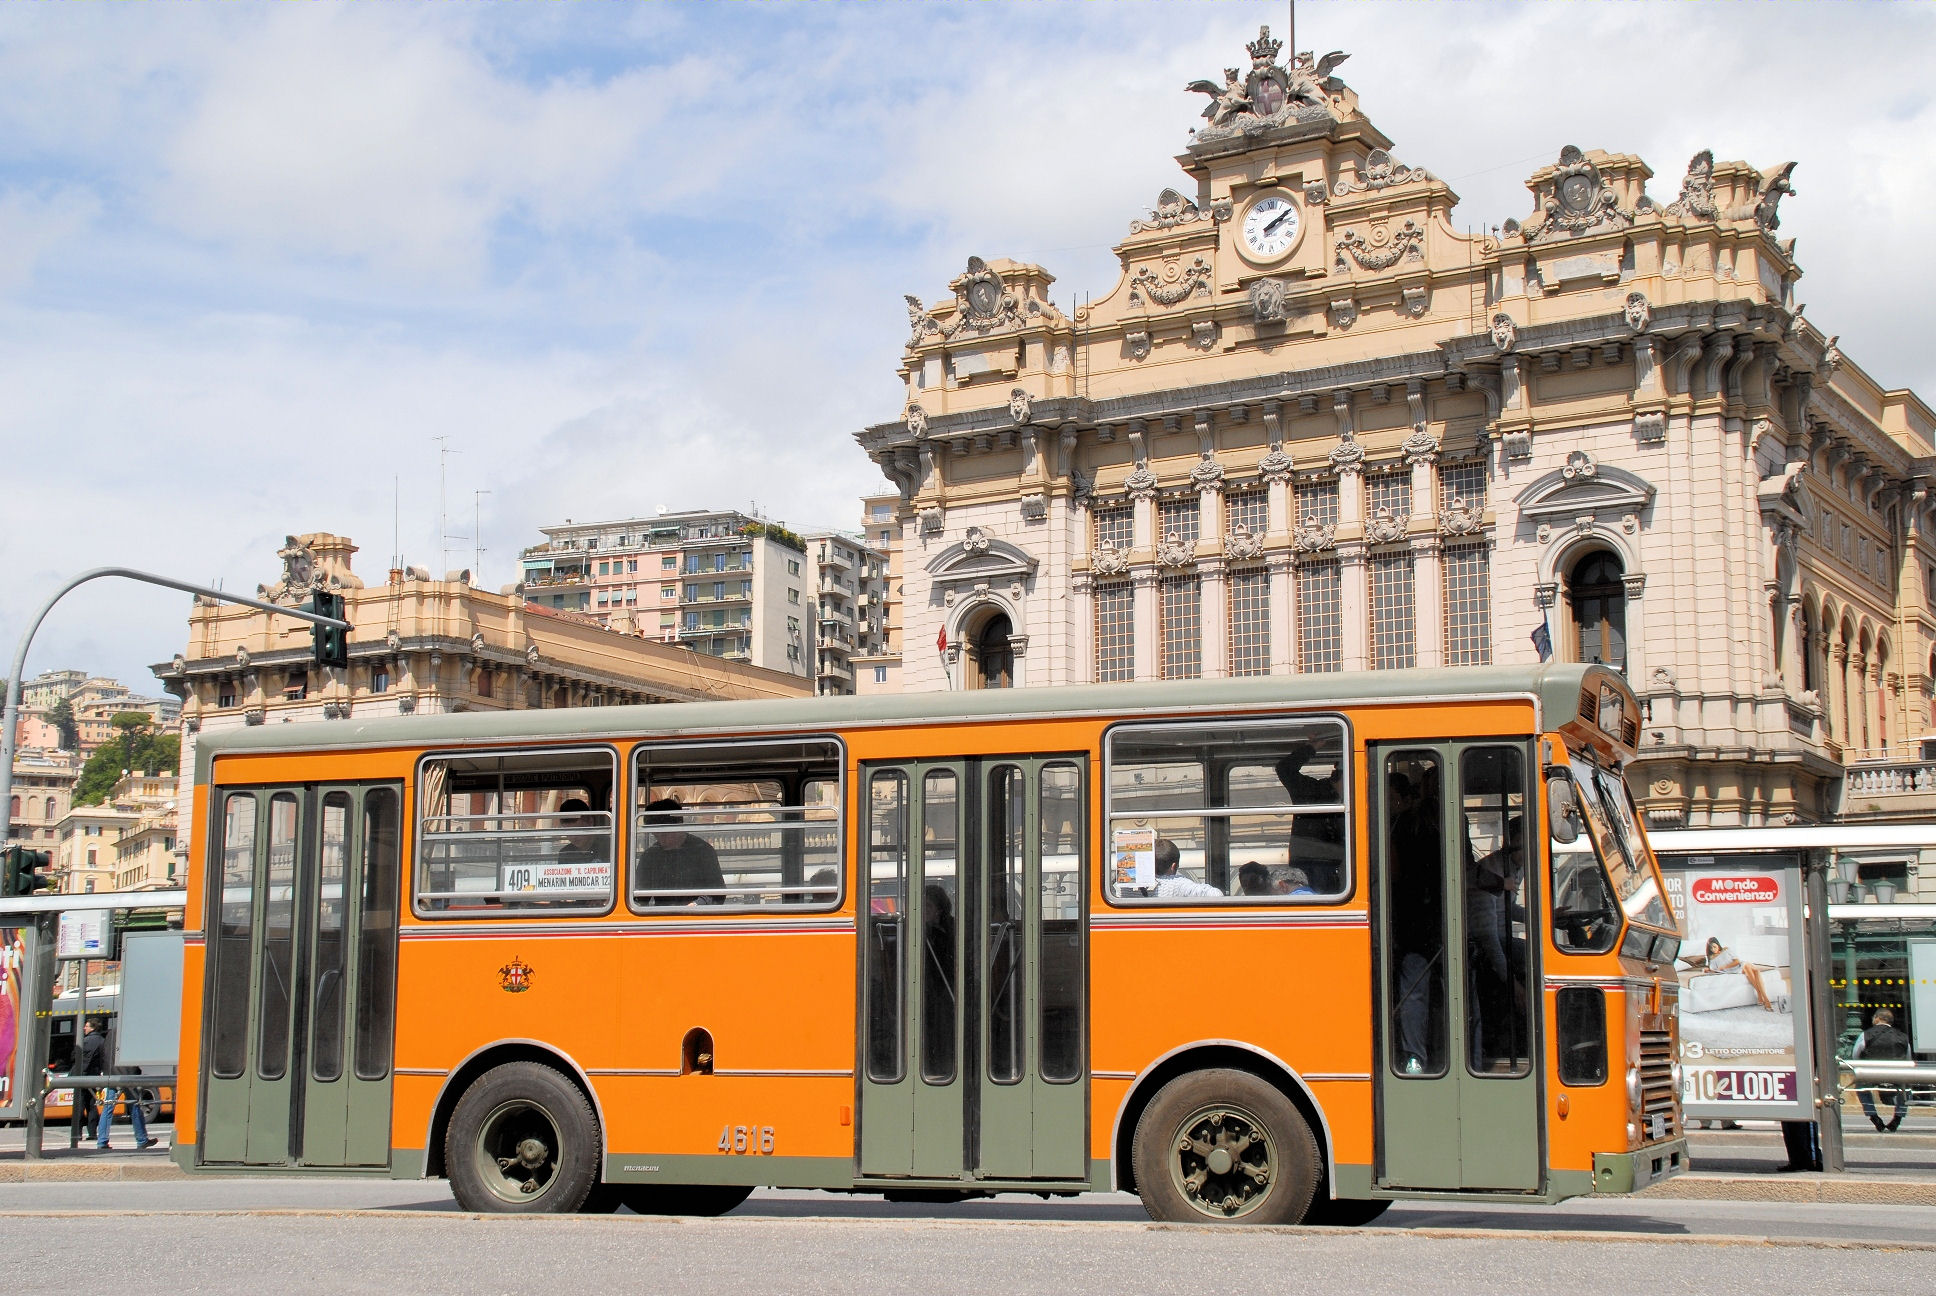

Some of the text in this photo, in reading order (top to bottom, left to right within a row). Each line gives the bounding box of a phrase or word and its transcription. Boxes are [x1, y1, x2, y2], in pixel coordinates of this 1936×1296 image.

[543, 868, 573, 876] ASSOCIAZIONE
[508, 869, 531, 891] 409
[538, 877, 567, 888] MENARINI
[568, 876, 600, 887] MONOCAR
[1696, 890, 1774, 901] Convenienza
[717, 1125, 775, 1153] 4616
